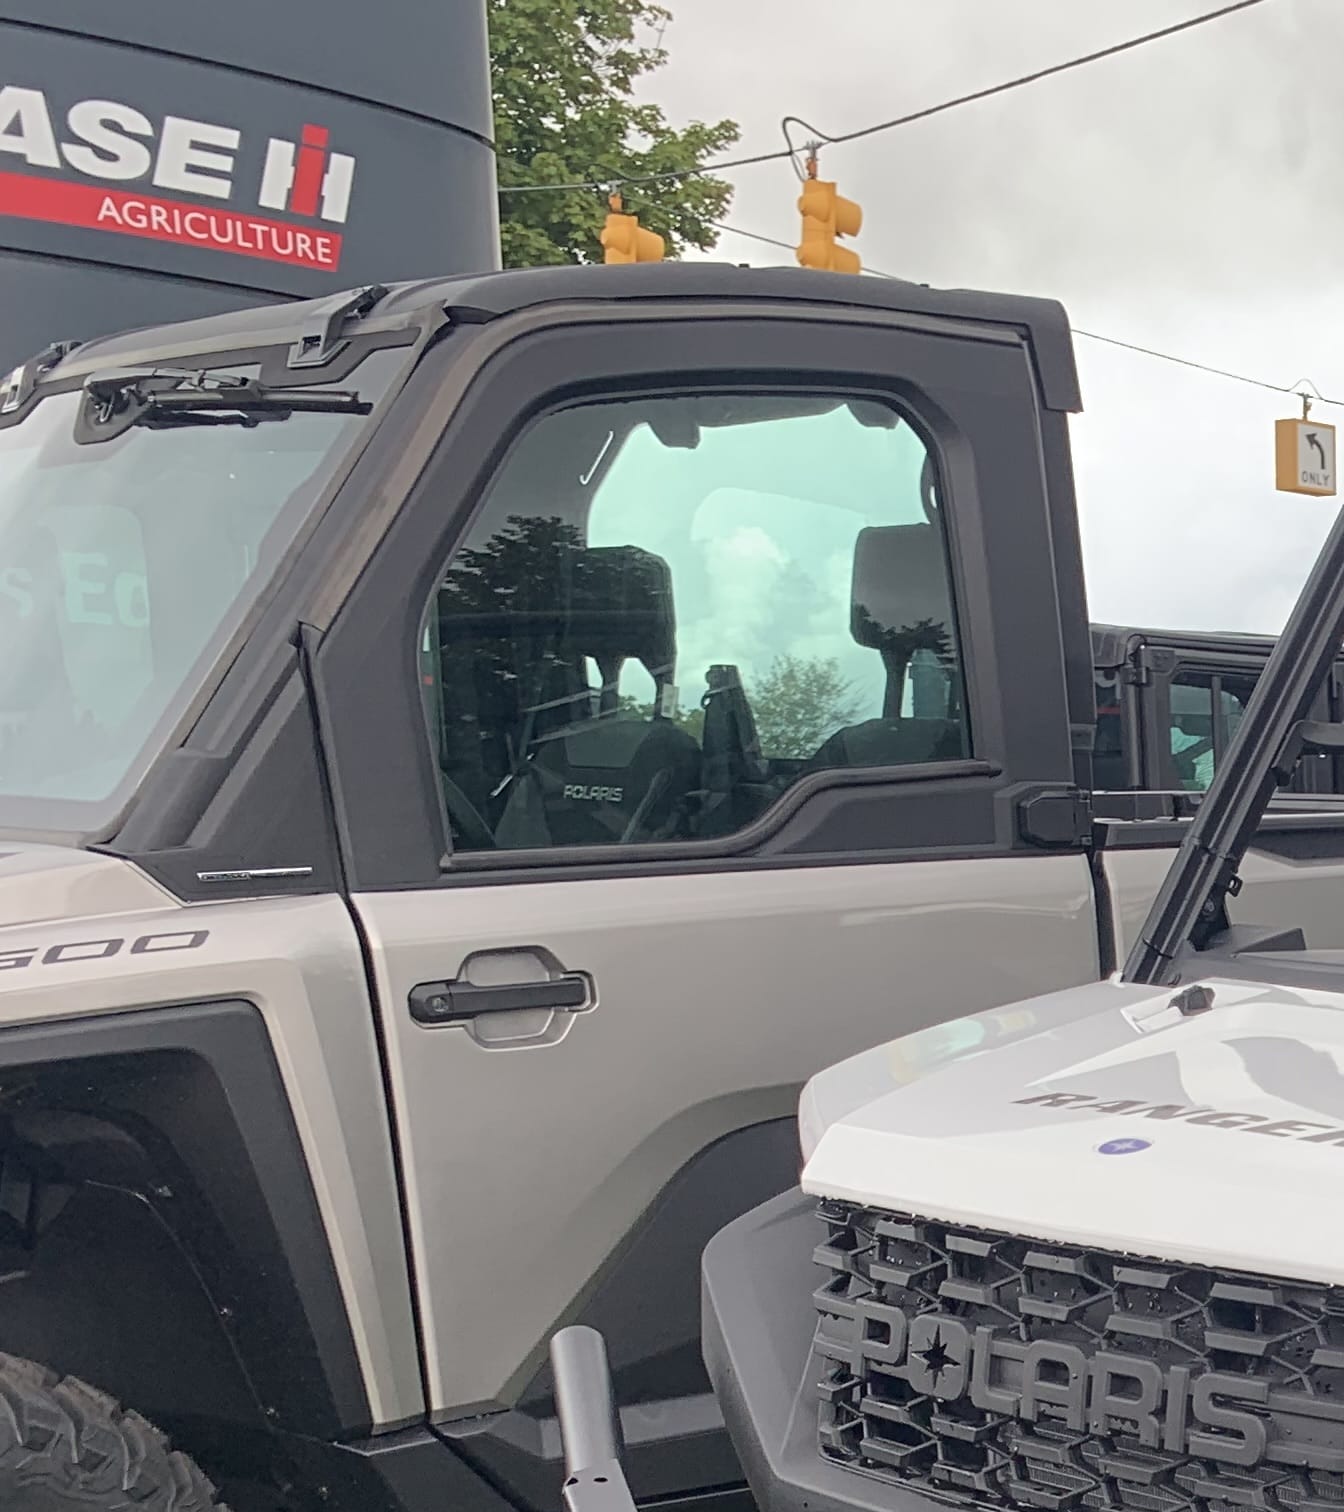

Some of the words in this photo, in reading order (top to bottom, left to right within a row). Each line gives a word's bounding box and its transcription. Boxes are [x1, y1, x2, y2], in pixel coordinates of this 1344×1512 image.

[97, 196, 333, 264] AGRICULTURE
[1302, 470, 1330, 486] ONLY
[563, 784, 623, 802] POLARIS
[853, 1299, 1271, 1467] POLARIS
